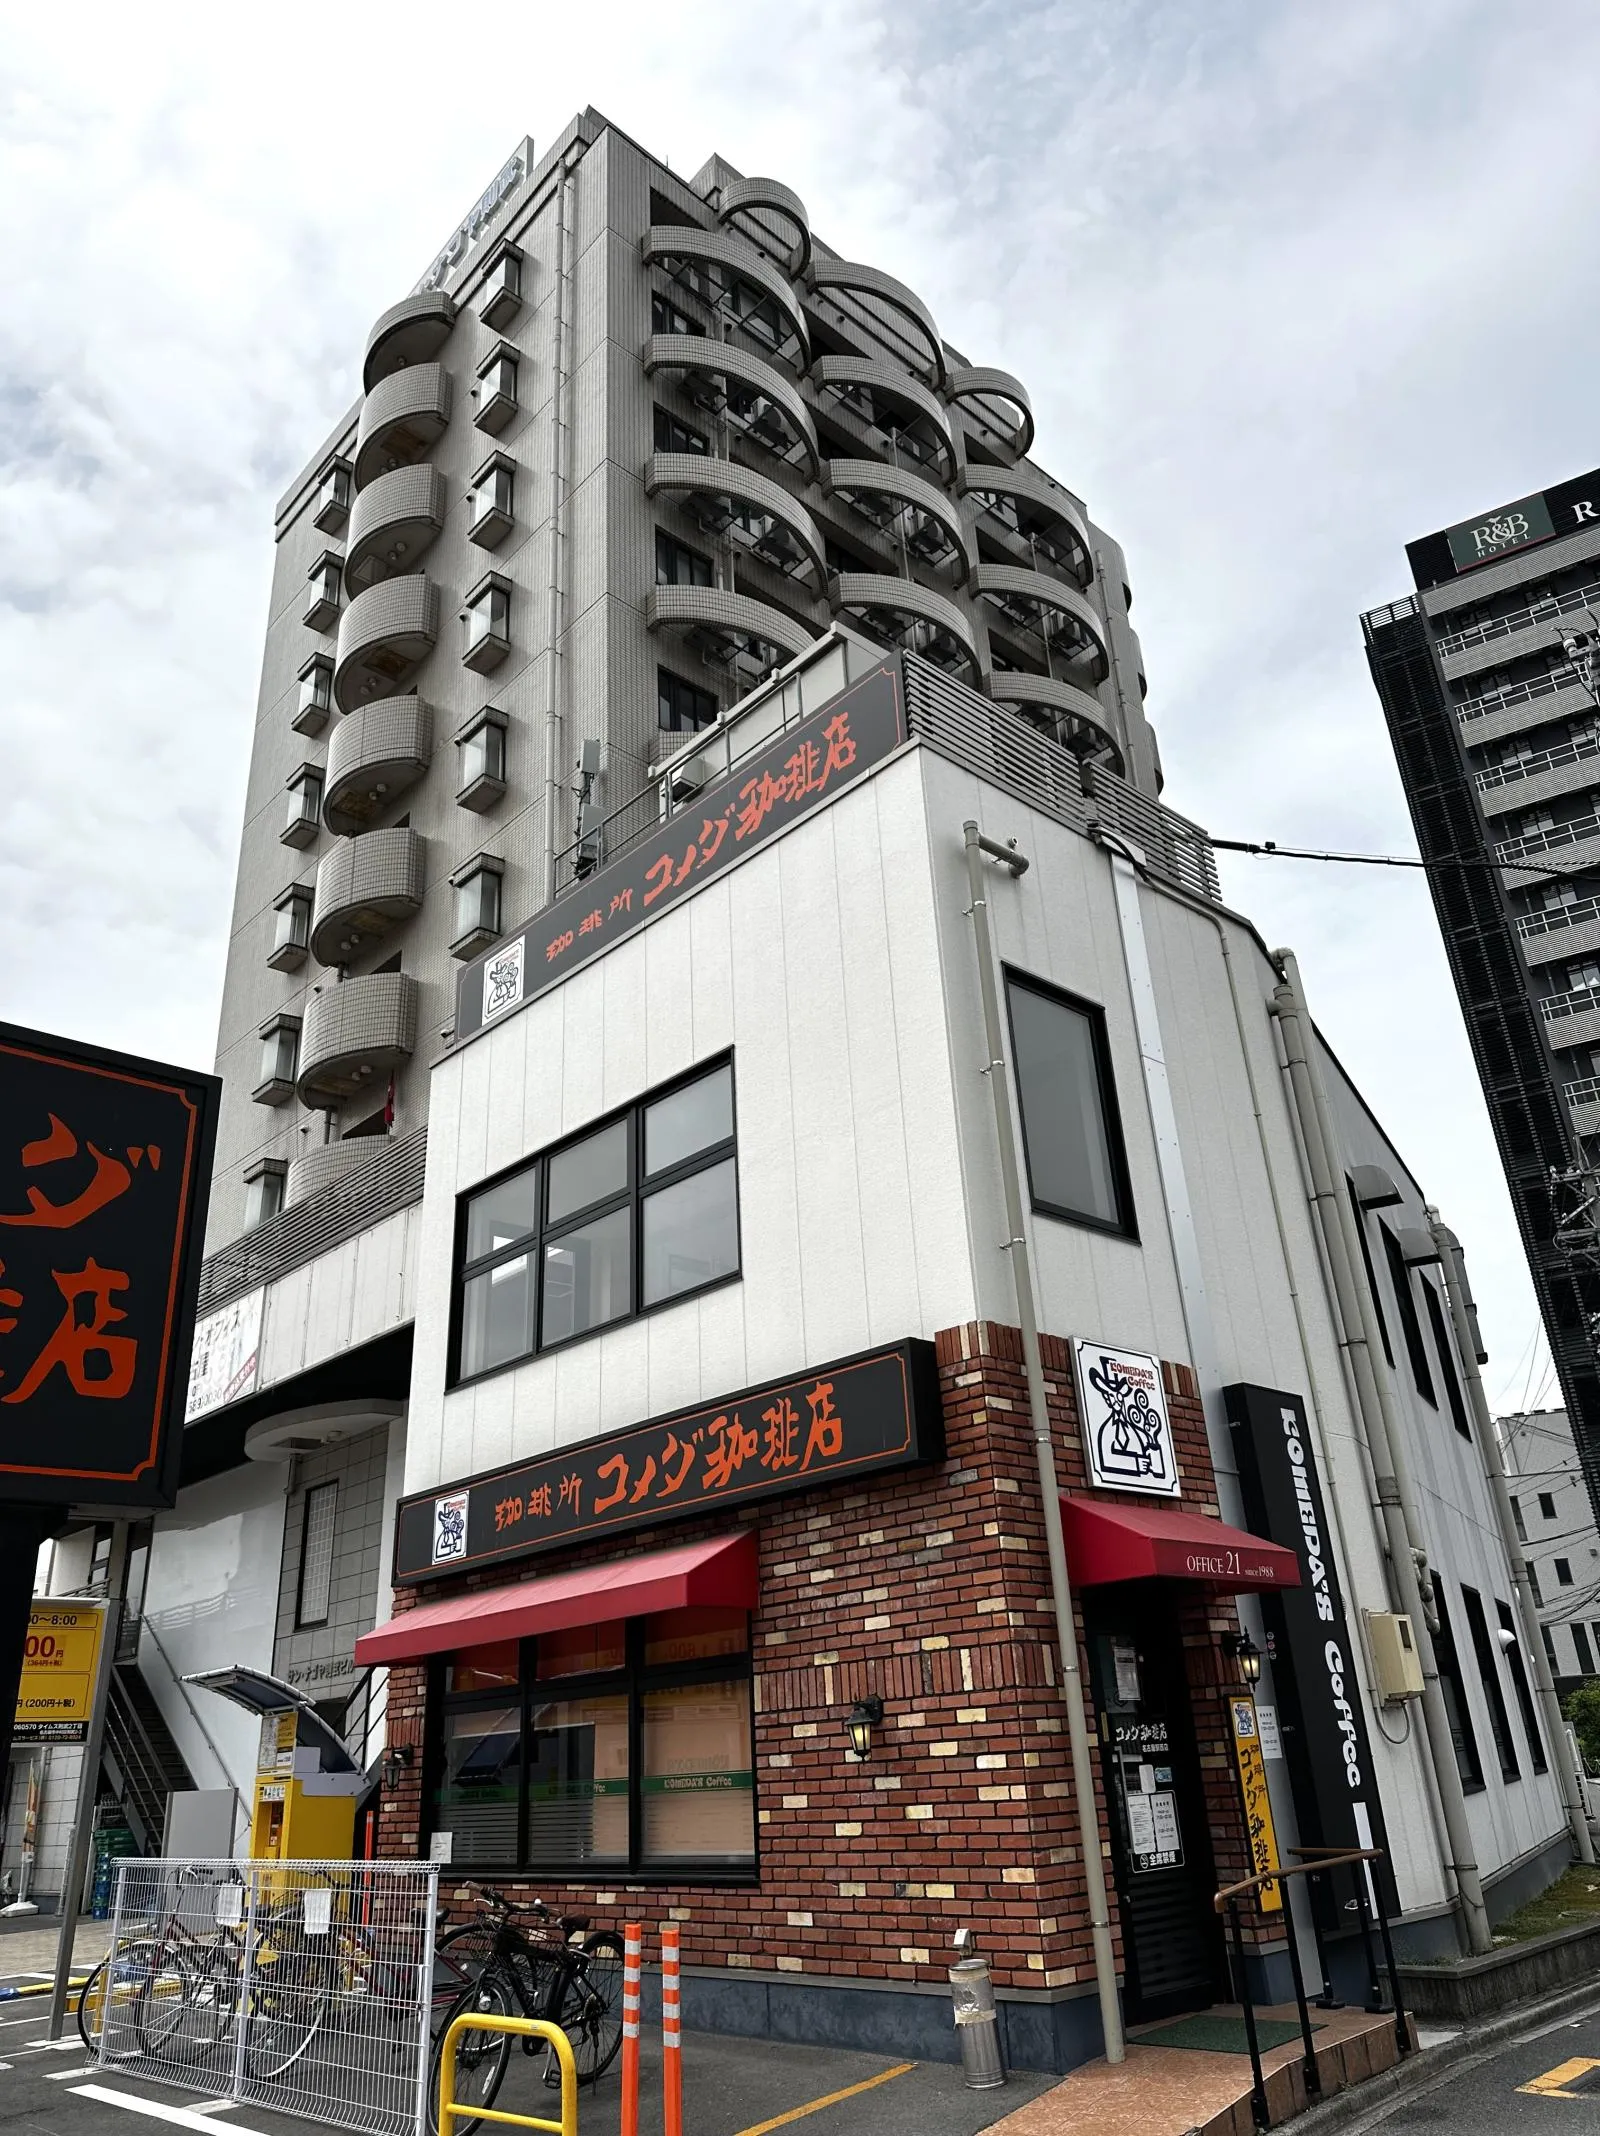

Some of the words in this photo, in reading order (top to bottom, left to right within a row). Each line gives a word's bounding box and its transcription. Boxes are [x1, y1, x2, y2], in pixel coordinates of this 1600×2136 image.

[1470, 513, 1529, 551] R&B
[1477, 533, 1531, 558] HOTEL
[546, 889, 632, 962] 珈琲所
[643, 711, 857, 906] コメダ珈琲店
[0, 1256, 138, 1404] 店
[1109, 1361, 1154, 1380] KOMEDA'S
[1127, 1376, 1156, 1391] Coffee
[495, 1474, 583, 1532] 珈琲所
[594, 1381, 844, 1514] コメダ珈琲店
[1186, 1555, 1224, 1573] OFFICE
[1226, 1551, 1241, 1575] 21
[1258, 1565, 1274, 1578] 1988
[1280, 1407, 1335, 1622] KOMEDA'S
[1325, 1640, 1361, 1788] Coffee
[1115, 1722, 1168, 1742] コメダ珈琲店
[1240, 1750, 1274, 1895] コメダ珈琲店
